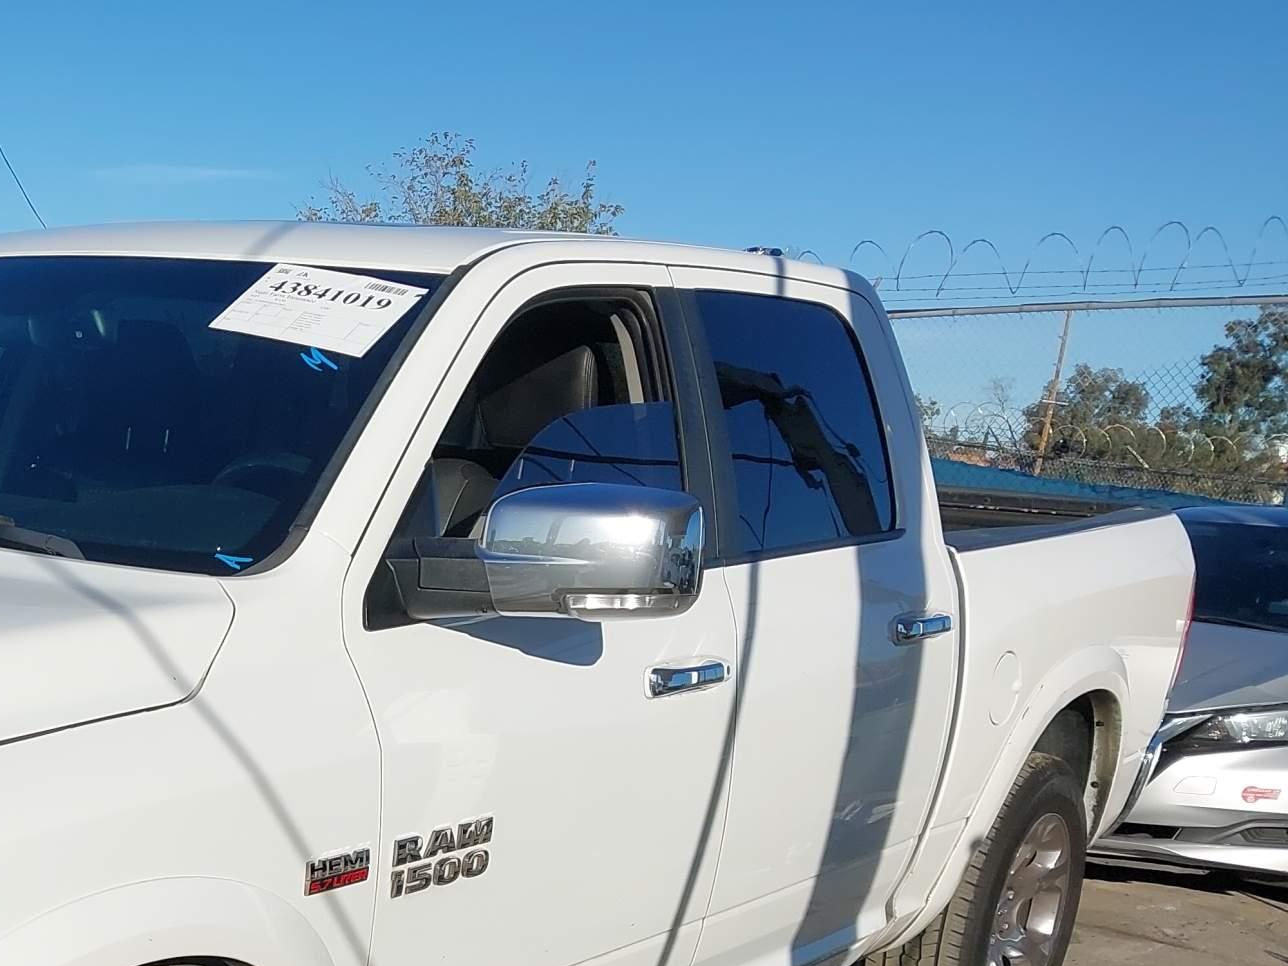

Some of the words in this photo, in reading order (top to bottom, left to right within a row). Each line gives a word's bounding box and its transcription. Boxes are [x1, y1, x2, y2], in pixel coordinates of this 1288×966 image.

[269, 280, 393, 310] 43841019
[392, 817, 493, 867] RAM
[305, 848, 370, 881] HEMI
[391, 849, 489, 898] 1500
